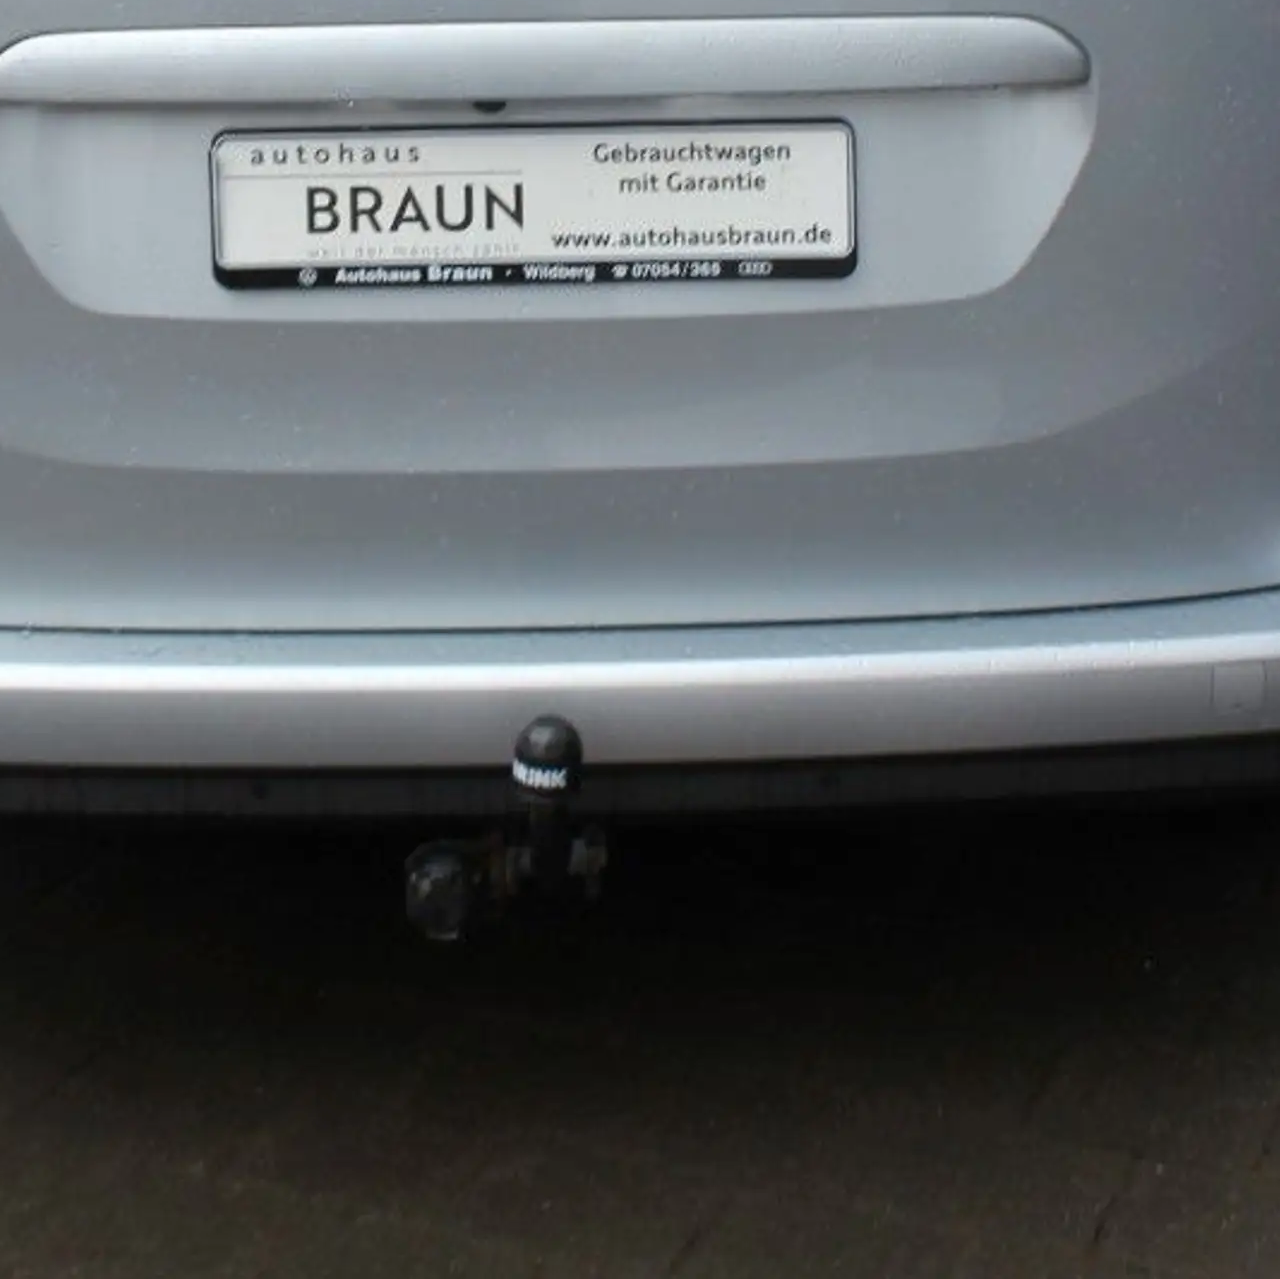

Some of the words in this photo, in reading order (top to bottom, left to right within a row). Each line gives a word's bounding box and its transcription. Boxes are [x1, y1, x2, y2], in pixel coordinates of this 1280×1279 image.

[250, 143, 421, 165] autohaus
[592, 141, 791, 166] Gebrauchtwagen
[619, 173, 660, 194] mit
[666, 171, 767, 193] Garantie
[306, 183, 524, 235] BRAUN
[551, 224, 832, 249] www.autohausbraun.de
[334, 267, 421, 285] Autohaus
[426, 265, 493, 282] Braun
